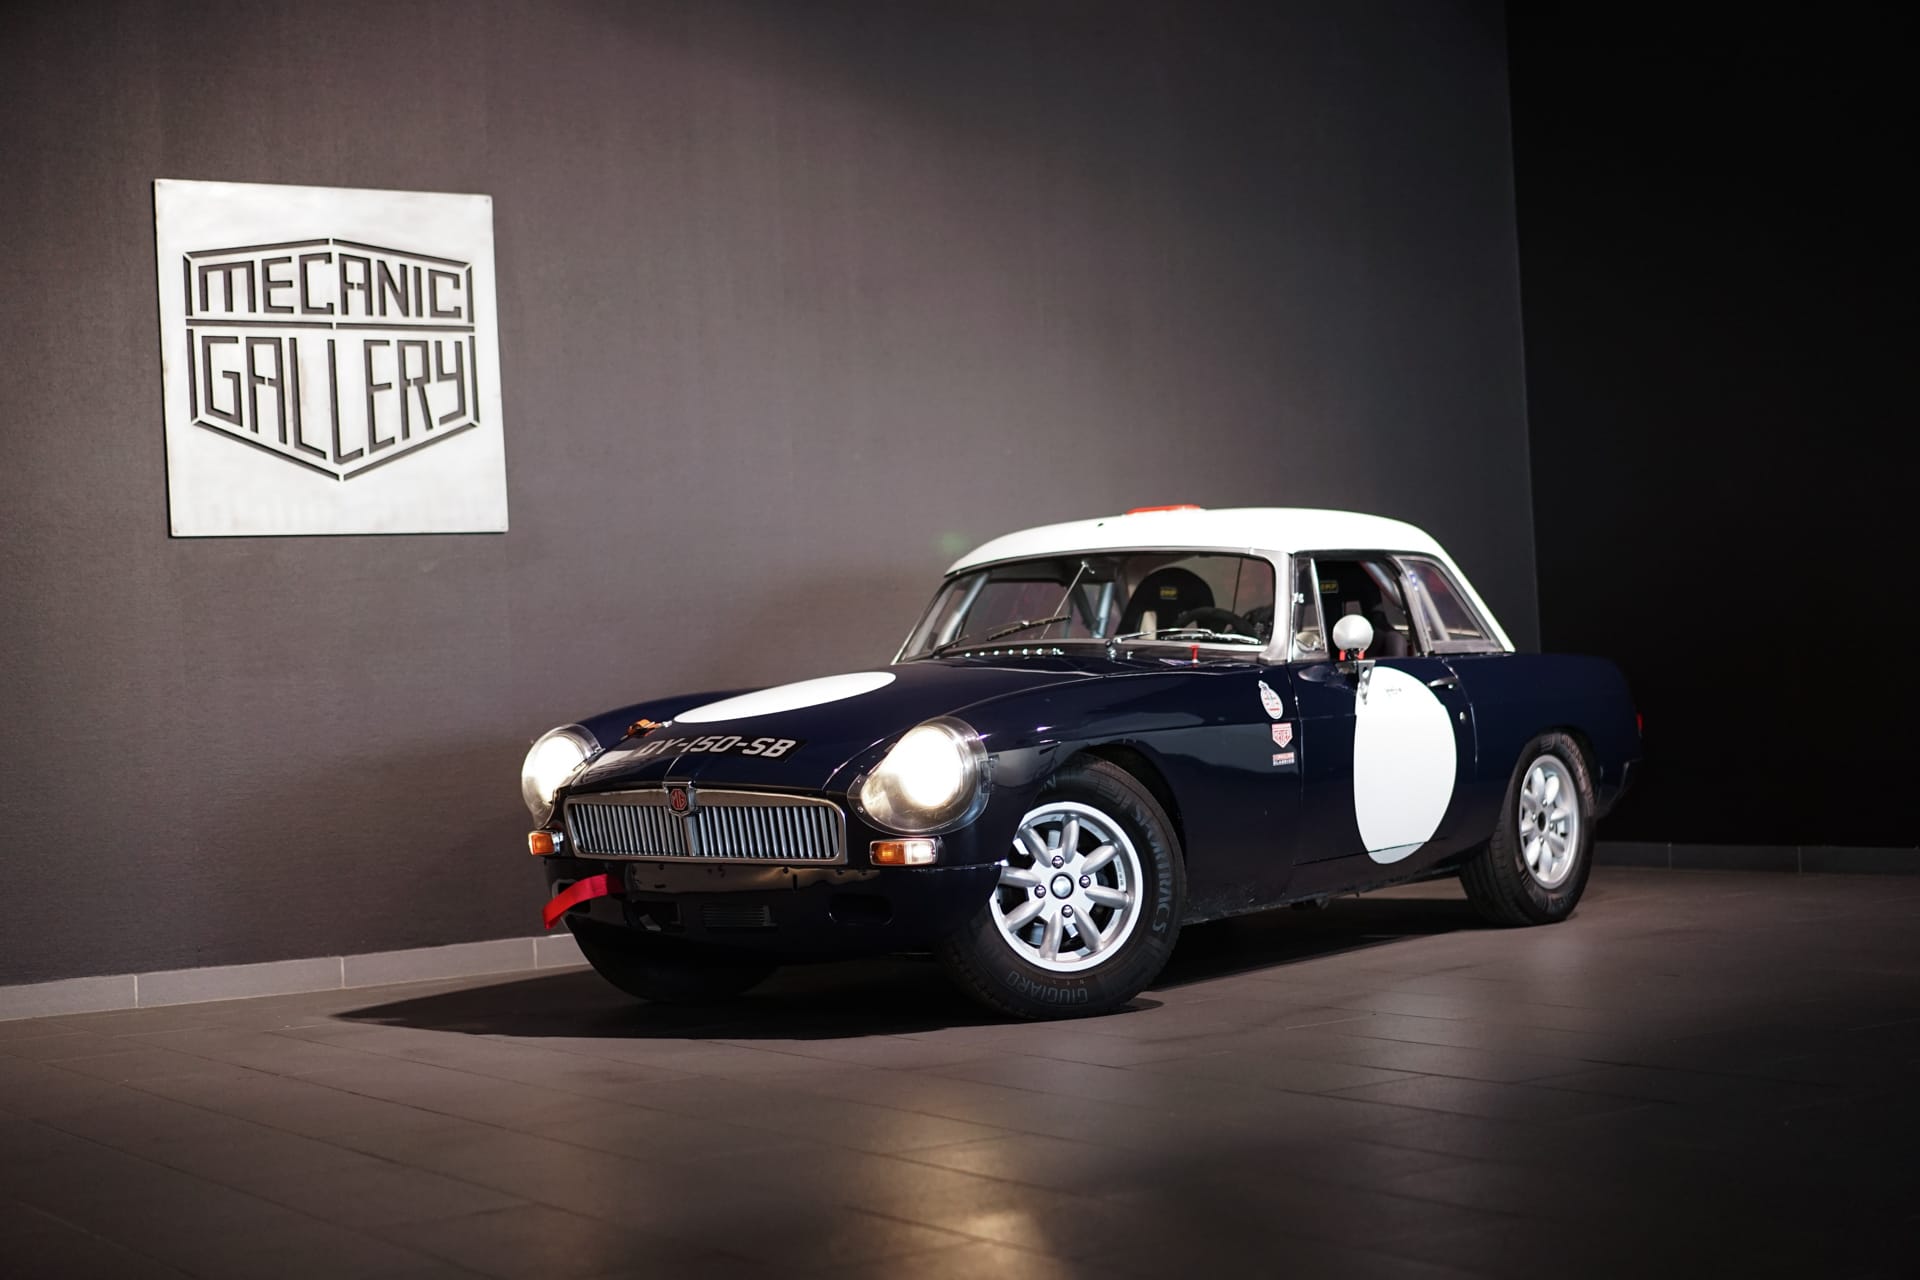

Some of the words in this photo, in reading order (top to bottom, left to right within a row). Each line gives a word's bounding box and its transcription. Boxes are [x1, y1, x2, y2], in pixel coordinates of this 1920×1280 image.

[198, 252, 462, 319] MECANIC
[201, 335, 467, 465] GALLERY
[671, 789, 686, 810] MG
[1006, 970, 1089, 1004] GIUGIARO
